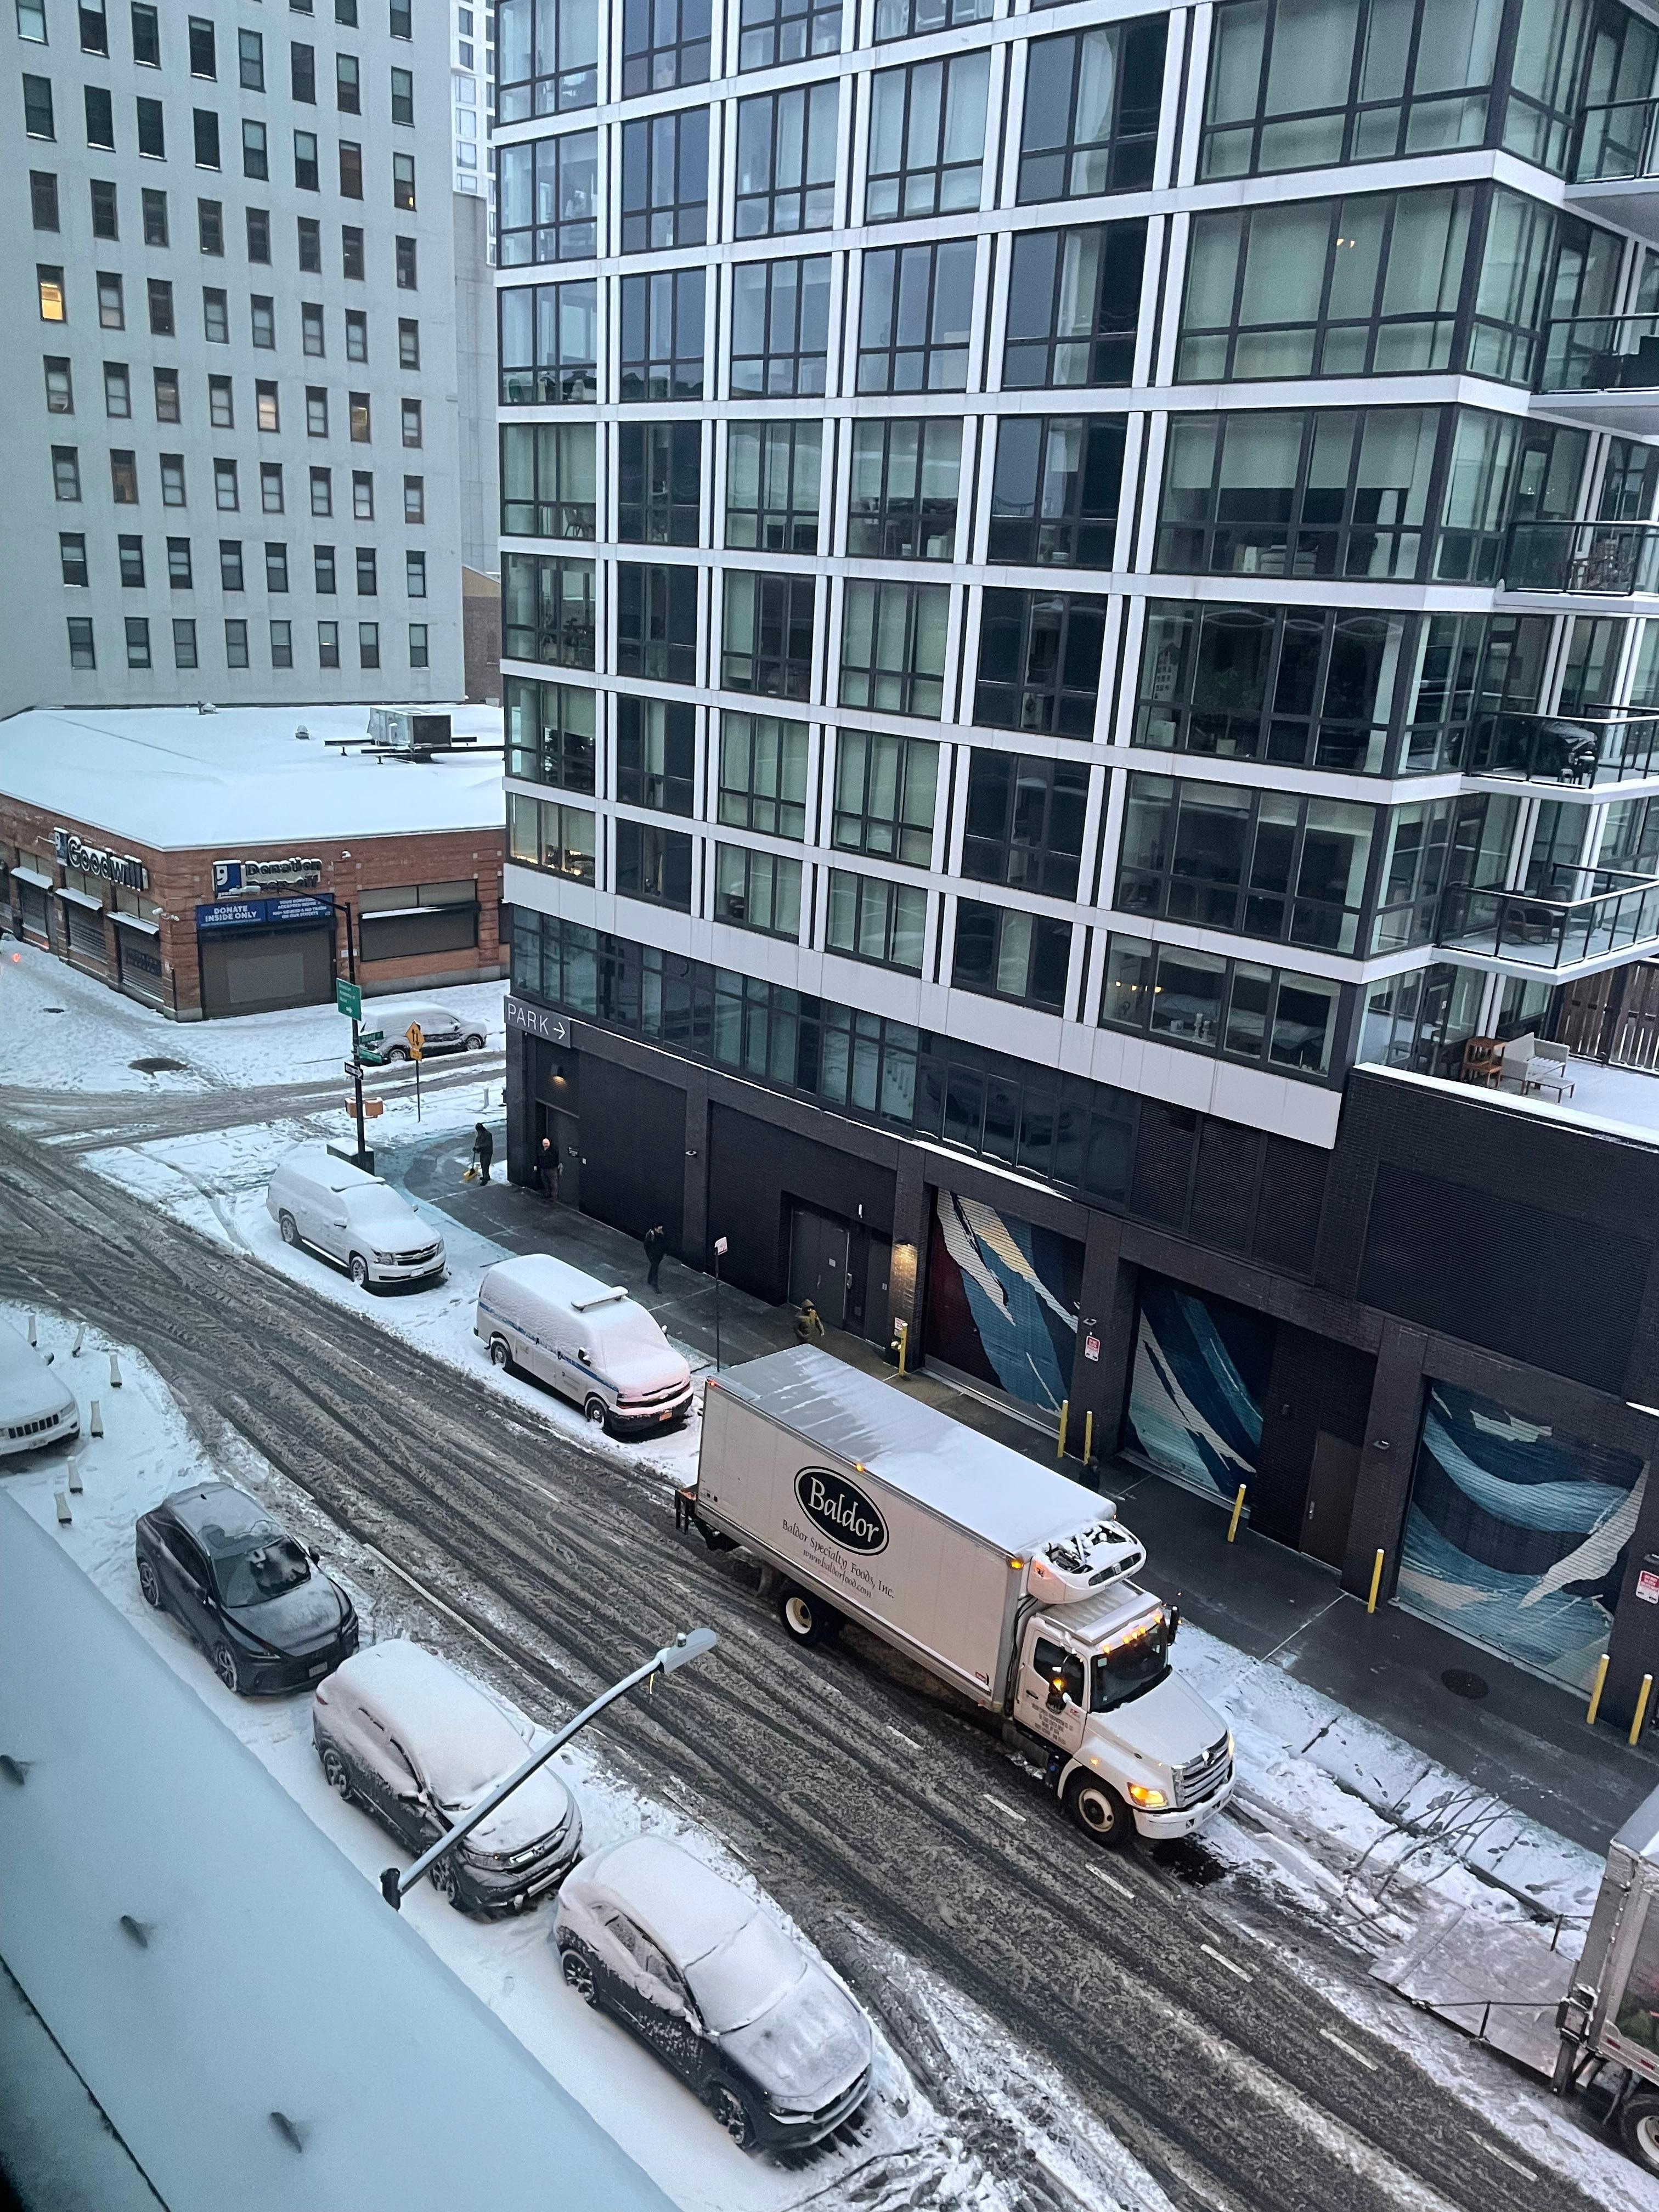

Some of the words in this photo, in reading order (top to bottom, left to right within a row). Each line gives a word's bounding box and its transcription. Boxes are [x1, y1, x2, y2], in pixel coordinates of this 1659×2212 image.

[67, 836, 144, 891] Goodwill
[246, 860, 322, 876] Donation
[205, 913, 234, 922] INSIDE
[234, 911, 257, 919] ONLY
[214, 905, 248, 915] DONATE
[507, 1003, 549, 1035] PARK
[808, 1476, 879, 1543] Baldor
[782, 1519, 808, 1543] Baldor
[810, 1537, 848, 1570] Specialty
[850, 1562, 876, 1589] Foods,
[878, 1579, 895, 1599] Inc.
